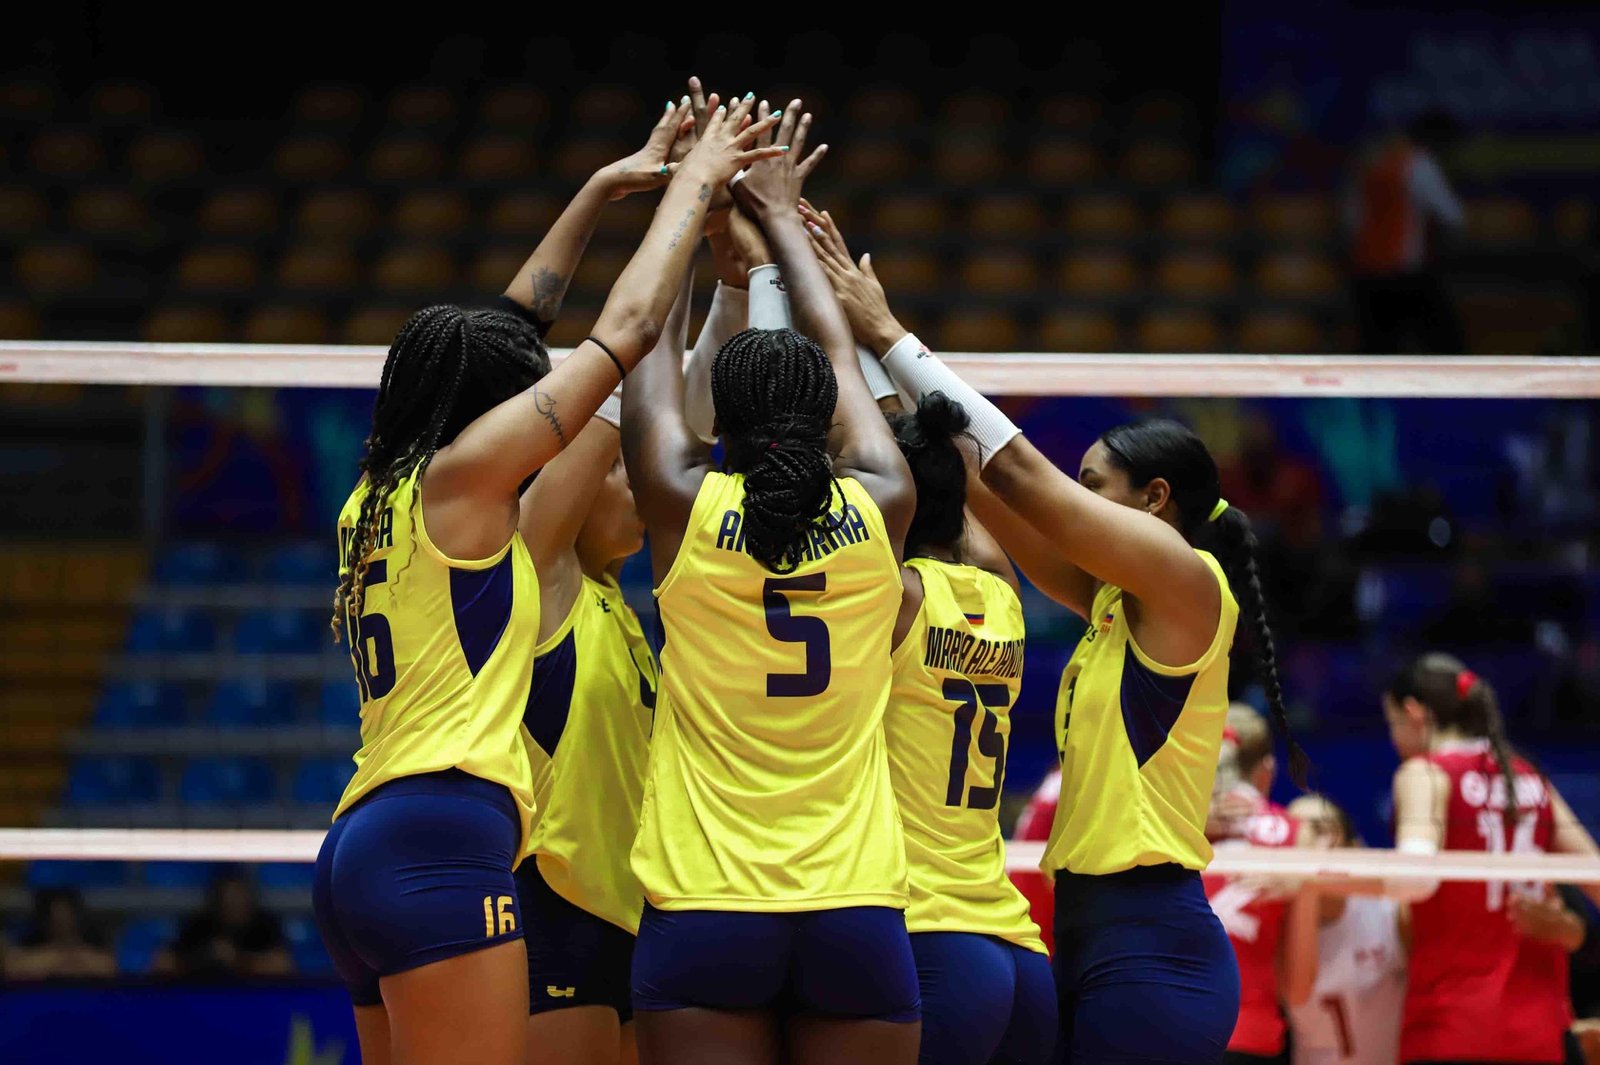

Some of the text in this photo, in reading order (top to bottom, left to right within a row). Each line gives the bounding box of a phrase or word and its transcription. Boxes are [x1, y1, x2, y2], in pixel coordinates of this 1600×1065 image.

[762, 571, 831, 698] 5
[941, 677, 1011, 810] 15
[483, 895, 516, 938] 16
